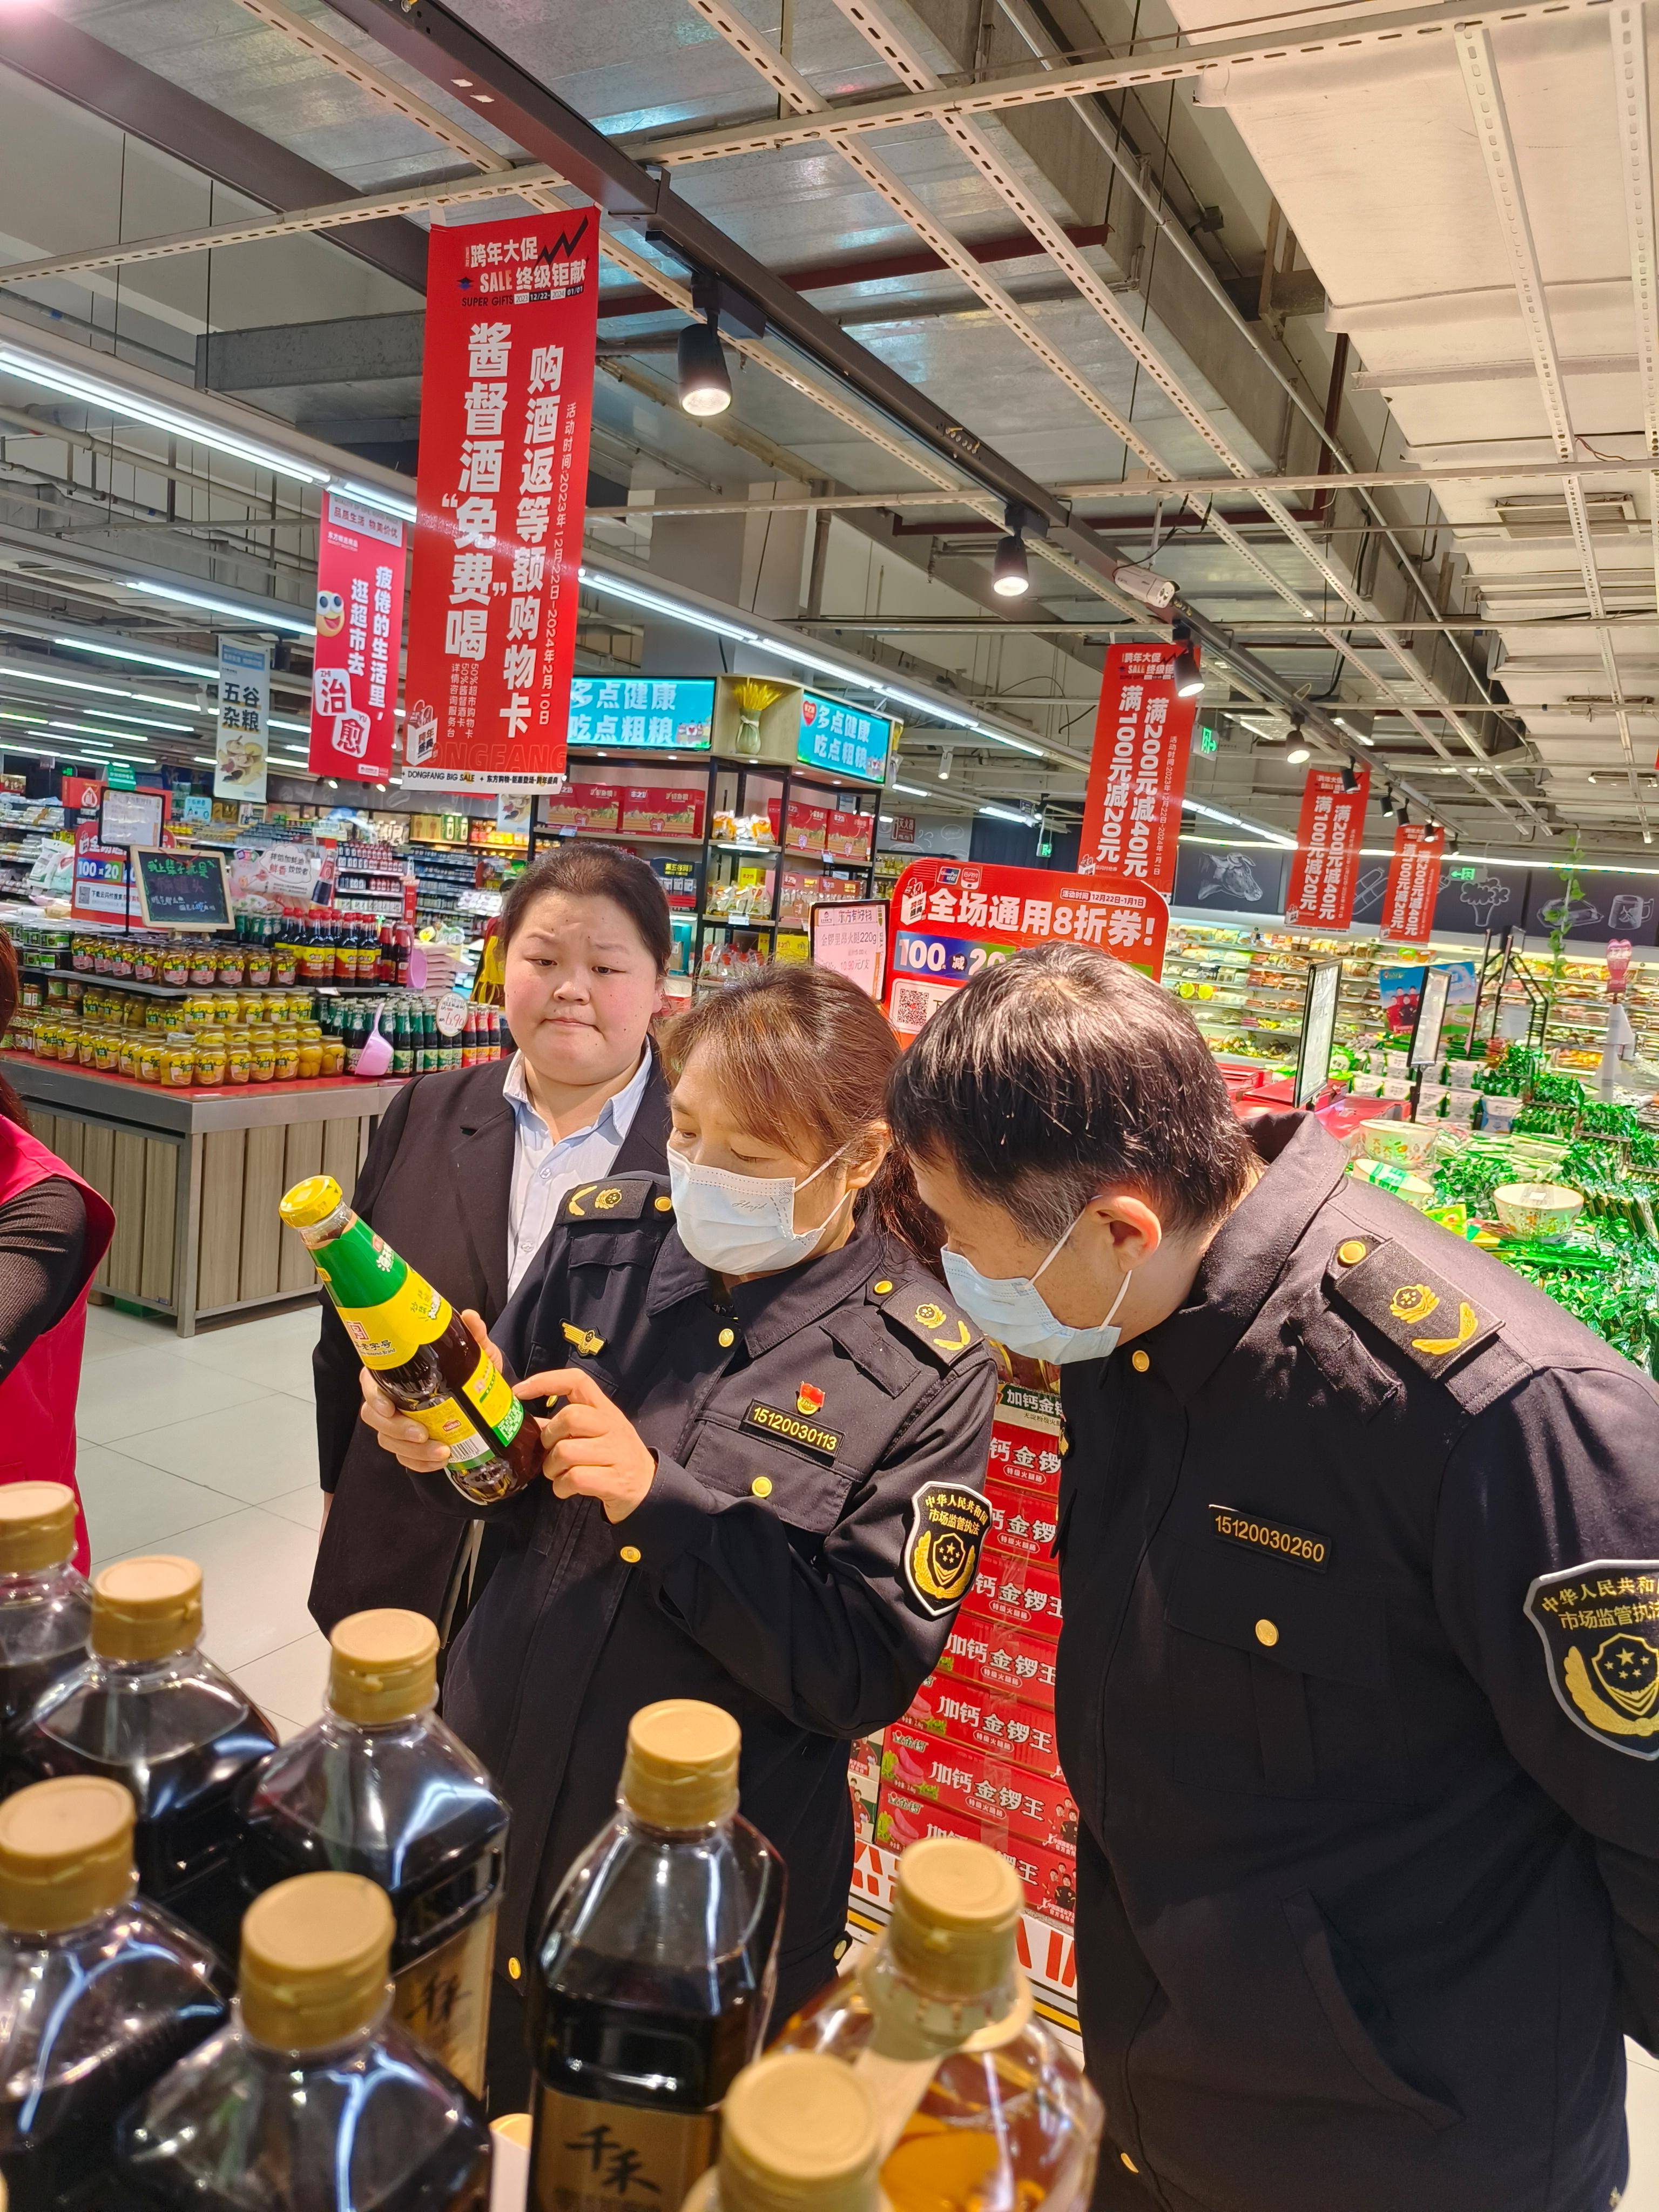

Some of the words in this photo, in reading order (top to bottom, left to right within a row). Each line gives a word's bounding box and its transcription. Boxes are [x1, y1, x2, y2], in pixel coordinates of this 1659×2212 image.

[471, 237, 538, 268] 跨年大促
[462, 297, 488, 307] SUPER
[491, 295, 514, 306] GIFTS
[515, 295, 529, 304] 2023
[552, 290, 564, 299] 2024
[480, 270, 513, 293] SALE
[499, 345, 564, 739] 购酒返等额购物卡
[347, 578, 368, 676] 逛超市去
[223, 682, 260, 708] 五谷
[447, 663, 460, 738] 详情咨询服务台
[570, 682, 677, 711] 多点健康
[222, 706, 259, 732] 杂粮
[569, 716, 674, 744] 吃点粗粮
[817, 704, 871, 743] 多点健康
[814, 734, 867, 770] 吃点粗粮
[408, 771, 444, 780] DONGFANG
[460, 774, 475, 783] SALE
[1096, 685, 1144, 864] 满100元减20元
[1122, 697, 1170, 878] 满200元减40元
[1299, 795, 1334, 911] 满100元减20元
[1318, 804, 1352, 921] 满200元减40元
[927, 888, 1156, 948] 全场通用8折券!
[1062, 890, 1089, 900] 活动时间
[1092, 894, 1144, 906] 12月22日-1月1日
[754, 1407, 837, 1451] 15120030113
[925, 1494, 988, 1526] 中华人民共和国
[928, 1508, 980, 1536] 市场监管执法
[1215, 1515, 1324, 1562] 15120030260
[971, 1572, 1063, 1618] 钙金锣王
[1541, 1576, 1659, 1614] 中华人民共和
[944, 1633, 1056, 1686] 加钙金锣王
[936, 1695, 1053, 1754] 加钙金锣王
[928, 1761, 1046, 1822] 加钙金锣王
